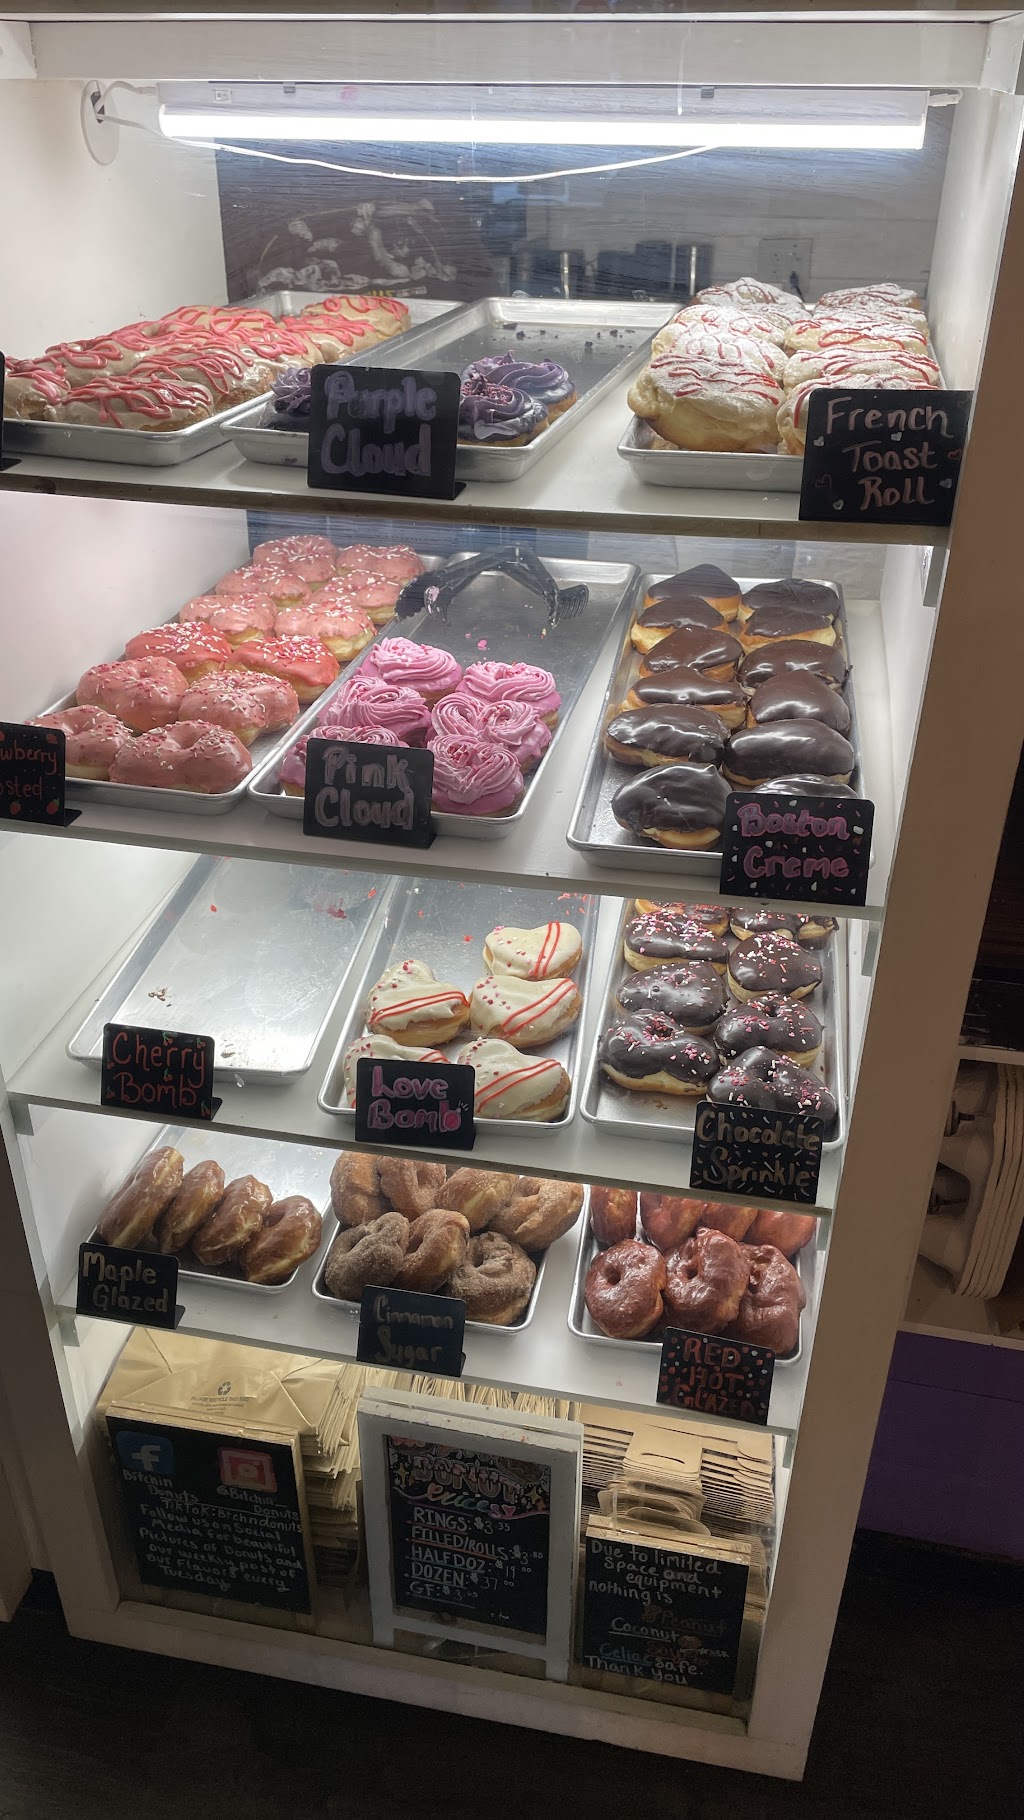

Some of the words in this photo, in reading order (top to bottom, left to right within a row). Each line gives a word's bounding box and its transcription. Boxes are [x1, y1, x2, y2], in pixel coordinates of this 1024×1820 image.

[324, 371, 437, 434] Purple
[827, 397, 954, 438] French
[321, 423, 431, 477] Cloud
[842, 440, 937, 472] Toast
[858, 476, 935, 510] Roll
[0, 740, 57, 775] wberry
[323, 745, 412, 793] Pink
[315, 787, 414, 830] Cloud
[737, 803, 850, 840] Boston
[743, 846, 849, 879] Creme
[113, 1032, 205, 1088] Cherry
[113, 1072, 196, 1108] Bomb
[371, 1065, 448, 1100] Love
[367, 1099, 461, 1133] Bomb
[697, 1109, 820, 1150] Chocolate
[703, 1146, 810, 1189] Sprinkle
[83, 1252, 156, 1292] Maple
[93, 1284, 168, 1312] Glazed
[373, 1294, 453, 1329] Cinnamon
[375, 1325, 442, 1367] Sugar
[683, 1338, 741, 1367] RED
[689, 1366, 744, 1392] HOT
[122, 1469, 173, 1488] Bitchin
[148, 1485, 198, 1502] Donuts
[413, 1454, 520, 1503] DONUT
[140, 1504, 188, 1523] Follow
[253, 1505, 299, 1521] Donuts
[414, 1507, 472, 1531] RINGS:
[224, 1545, 272, 1563] Donuts
[276, 1558, 303, 1570] and
[232, 1534, 296, 1557] beautiful
[592, 1540, 623, 1558] Due
[629, 1545, 648, 1562] to
[654, 1550, 721, 1574] limited
[244, 1573, 290, 1592] every
[411, 1562, 469, 1587] DOZEN:
[626, 1573, 722, 1599] equipment
[664, 1570, 701, 1584] and
[589, 1580, 650, 1606] nothing
[657, 1591, 672, 1604] is
[610, 1617, 680, 1642] Coconut
[585, 1655, 644, 1676] Thank
